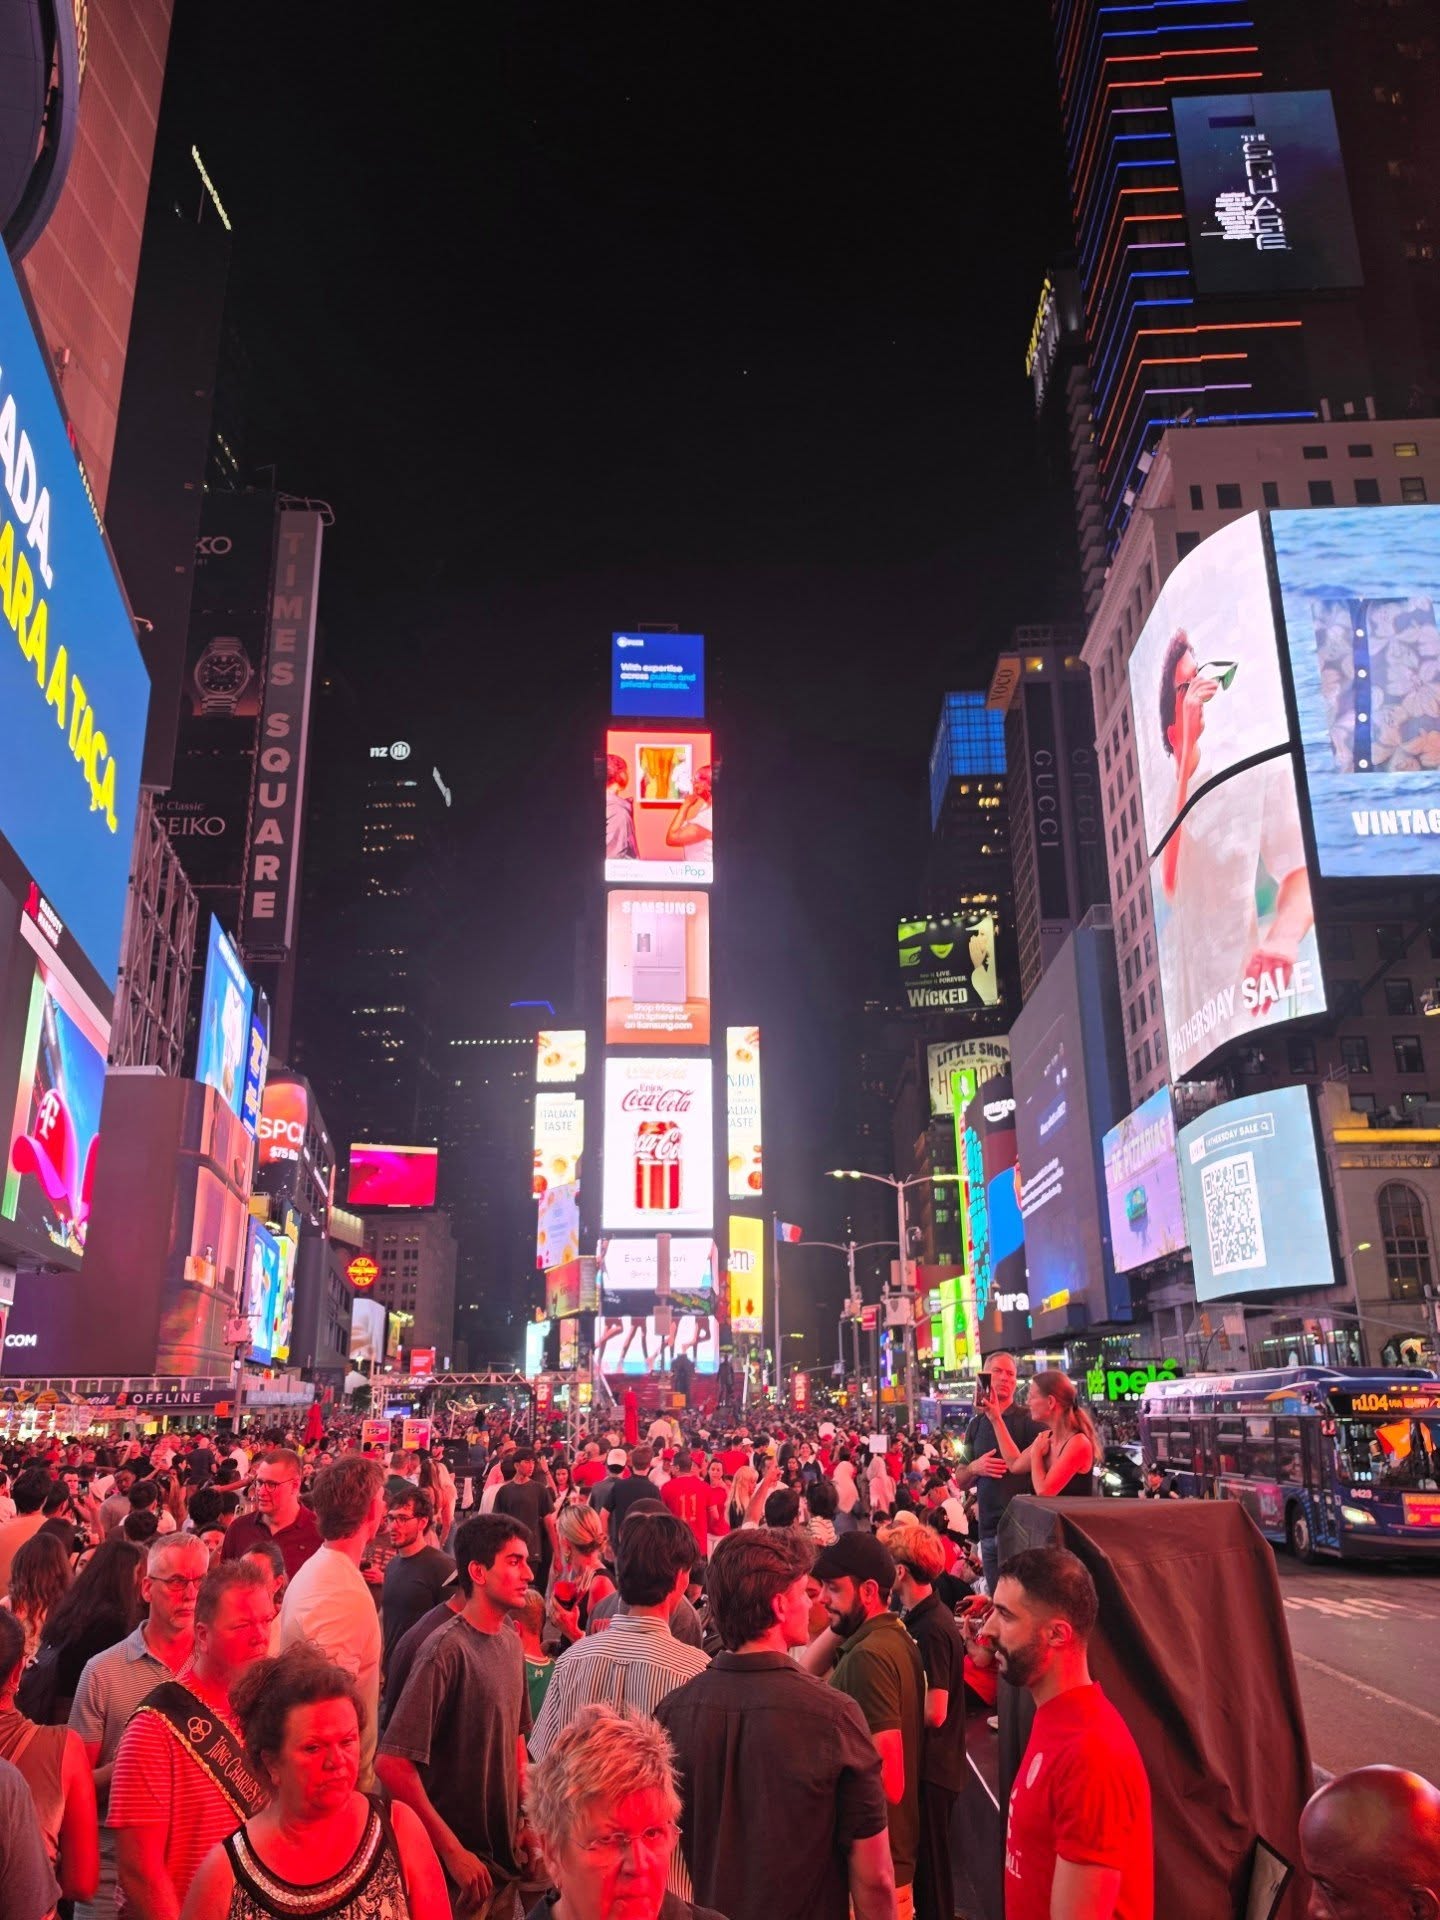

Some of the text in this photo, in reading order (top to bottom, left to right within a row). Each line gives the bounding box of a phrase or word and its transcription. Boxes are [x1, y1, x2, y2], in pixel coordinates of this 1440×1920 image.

[620, 663, 683, 673] With expertise
[650, 673, 677, 681] public
[46, 645, 67, 729] A
[251, 532, 304, 919] TIMES SQUARE
[1034, 750, 1059, 846] GUCCI
[621, 901, 697, 915] SAMSUNG
[1241, 960, 1315, 1009] SALE
[636, 1021, 693, 1032] Samsung.com
[937, 1042, 1009, 1067] LITTLE SHOP
[544, 1121, 573, 1131] TASTE
[1239, 1123, 1258, 1136] SALE
[132, 1392, 201, 1404] OFFLINE
[680, 1493, 697, 1521] 11
[224, 1757, 261, 1803] CHARLES
